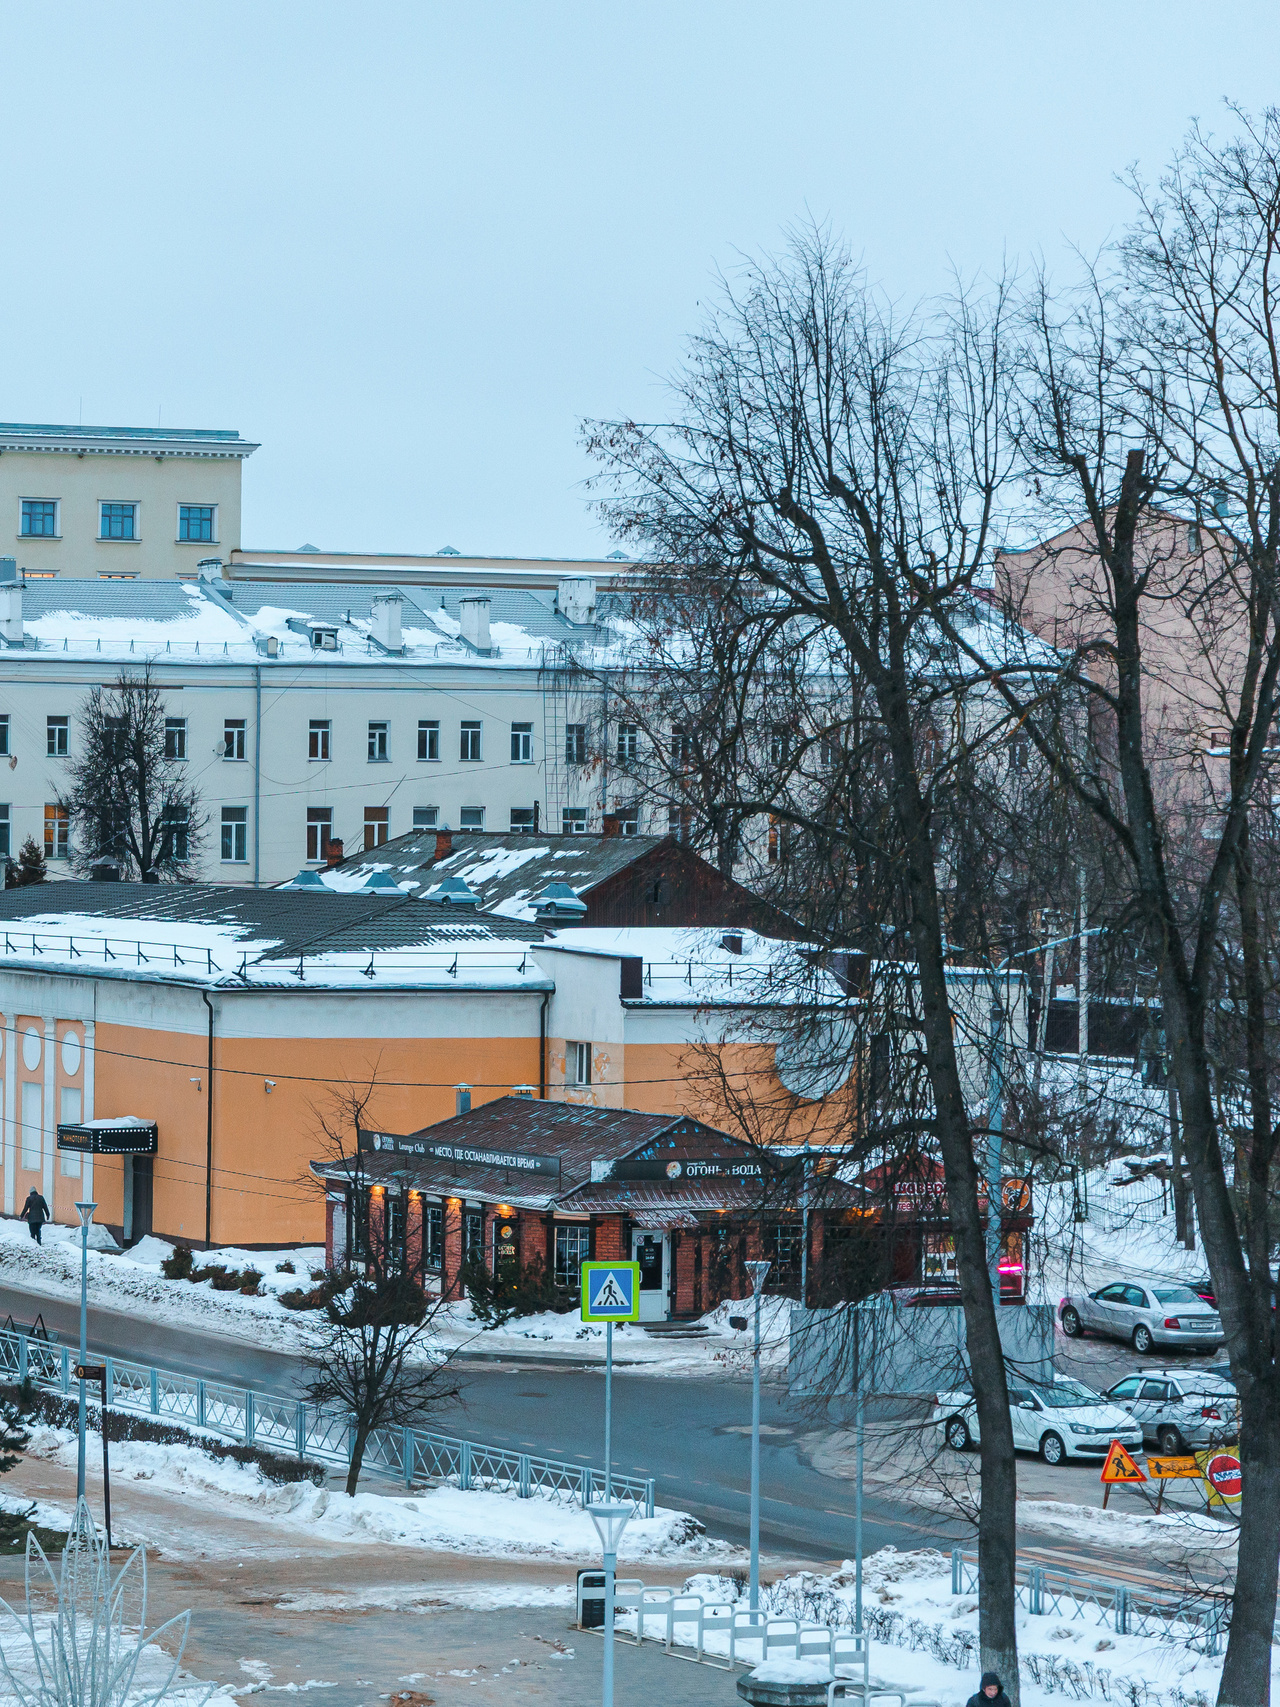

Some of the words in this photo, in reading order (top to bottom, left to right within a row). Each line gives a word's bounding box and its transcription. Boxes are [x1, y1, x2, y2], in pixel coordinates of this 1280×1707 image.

[398, 1141, 414, 1153] Lounge
[414, 1143, 425, 1153] Club
[454, 1149, 464, 1160] ГДЕ
[464, 1150, 517, 1166] ОСТАНАВЛИВАЕТСЯ
[517, 1157, 535, 1169] ВРЕМЯ
[731, 1165, 762, 1175] ВОДА
